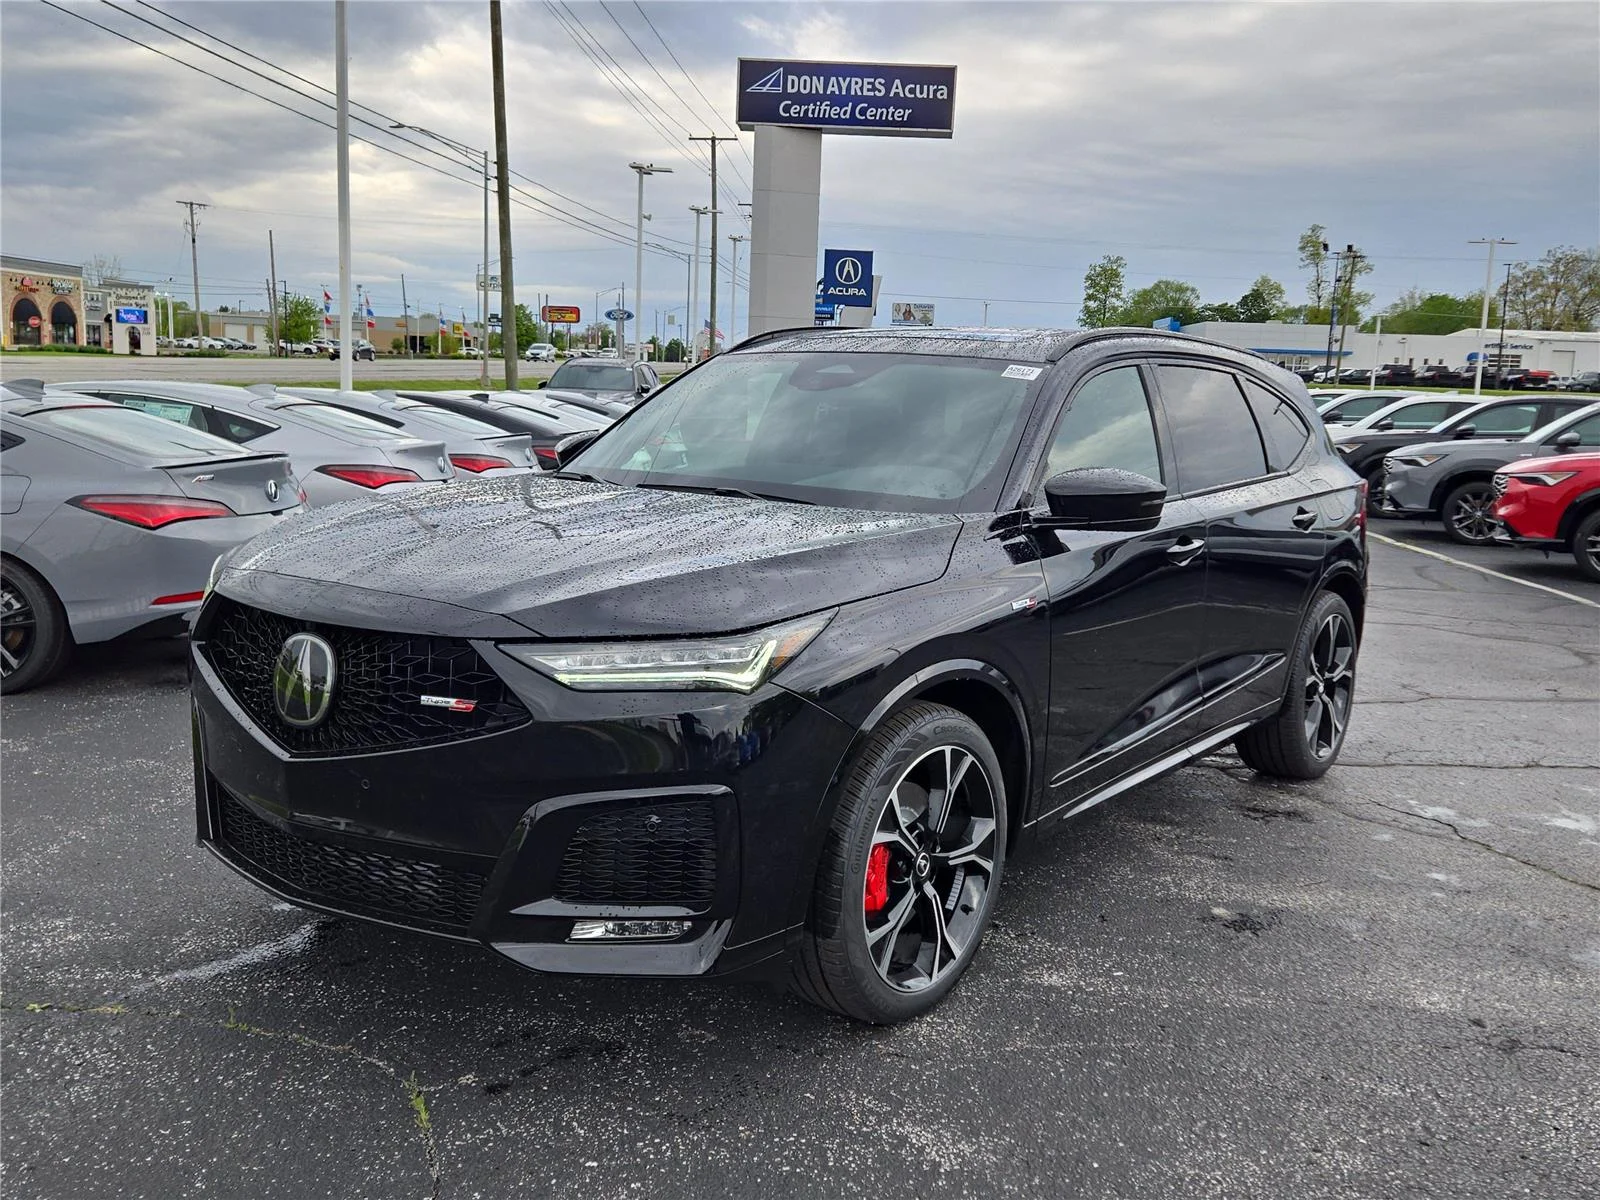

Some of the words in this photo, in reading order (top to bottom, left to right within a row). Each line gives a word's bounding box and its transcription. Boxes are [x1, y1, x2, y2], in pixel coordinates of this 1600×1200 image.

[787, 75, 824, 94] DON
[827, 77, 885, 97] AYRES
[889, 79, 948, 100] Acura
[778, 100, 851, 119] Certified
[855, 103, 912, 121] Center
[827, 287, 867, 296] ACURA
[1484, 342, 1509, 350] ertified
